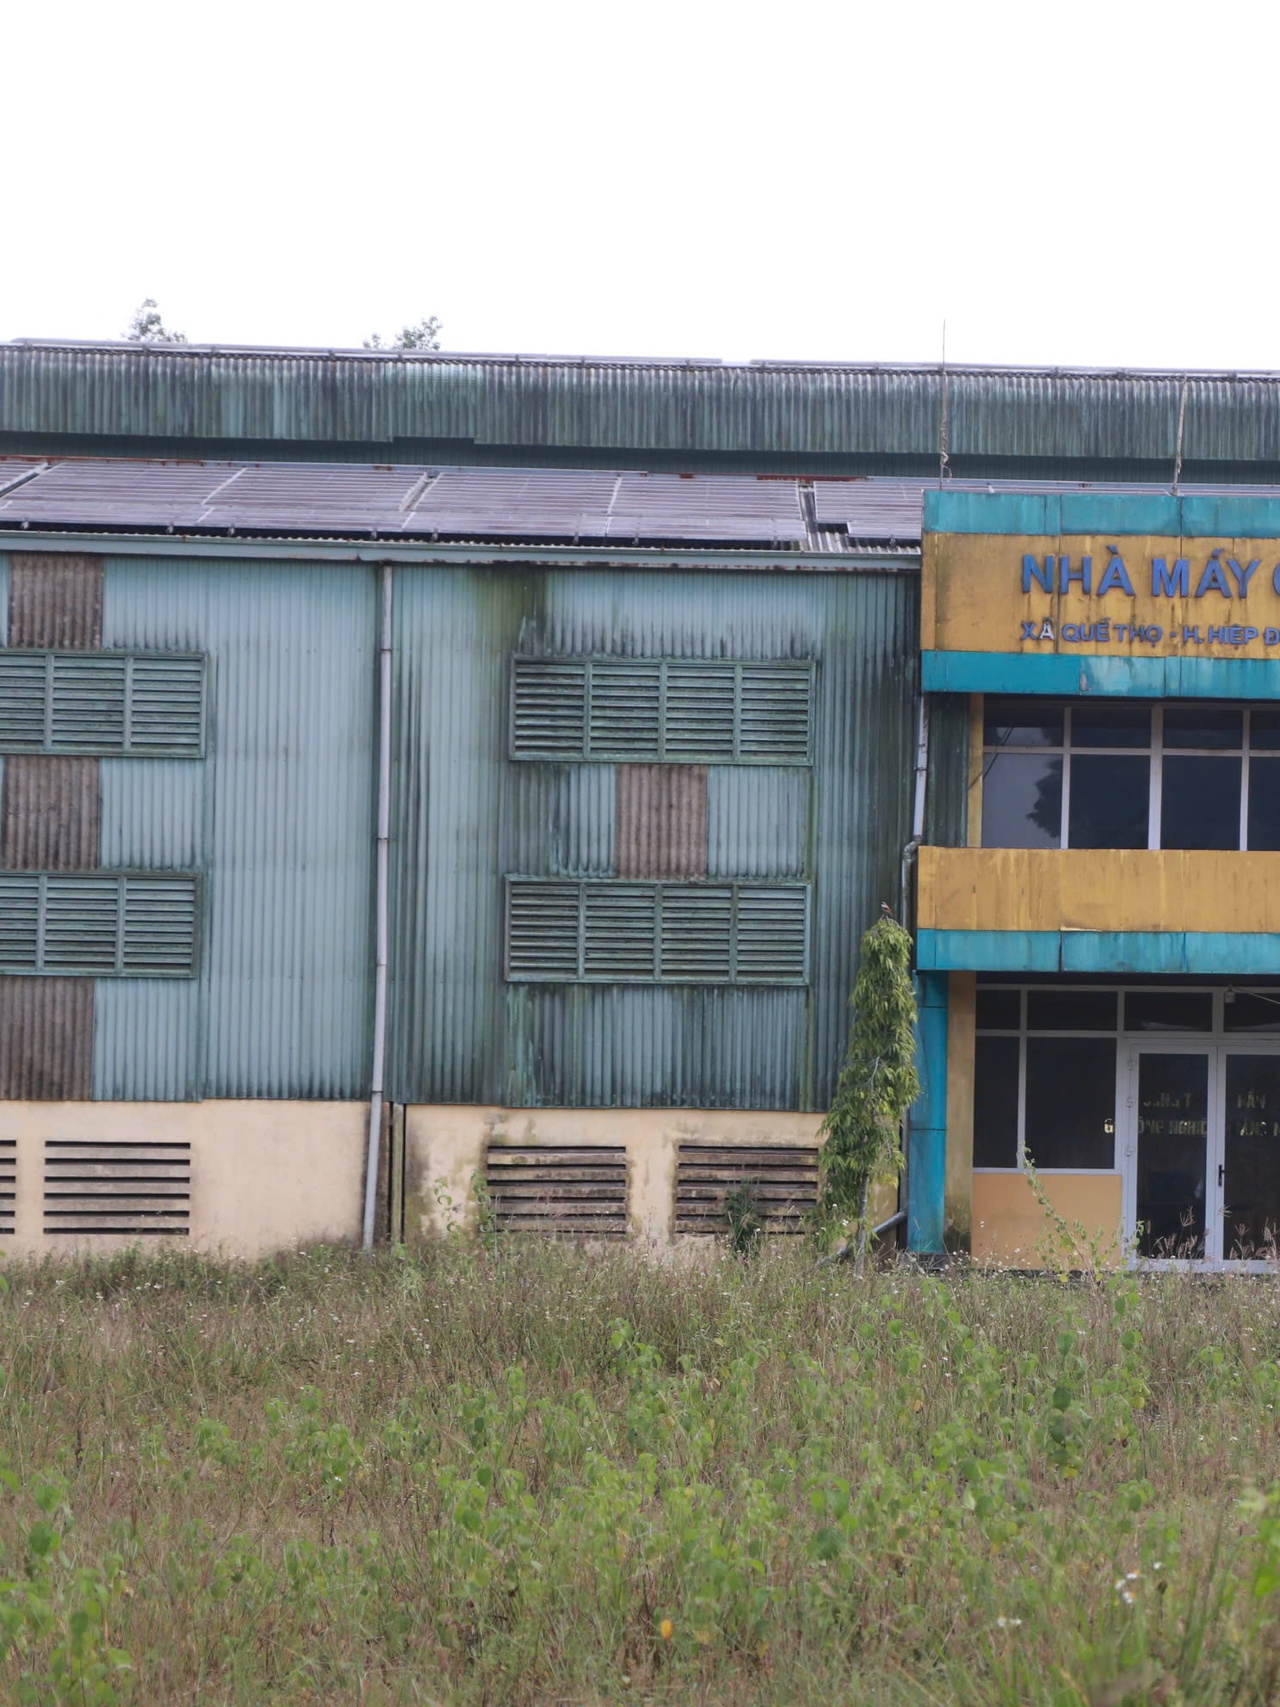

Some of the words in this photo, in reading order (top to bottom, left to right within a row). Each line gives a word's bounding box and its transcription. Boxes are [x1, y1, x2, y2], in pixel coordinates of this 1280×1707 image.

[1021, 544, 1135, 595] NHÀ
[1151, 547, 1261, 599] MÁY
[1062, 617, 1111, 642] QUẾ
[1113, 624, 1163, 648] THỌ
